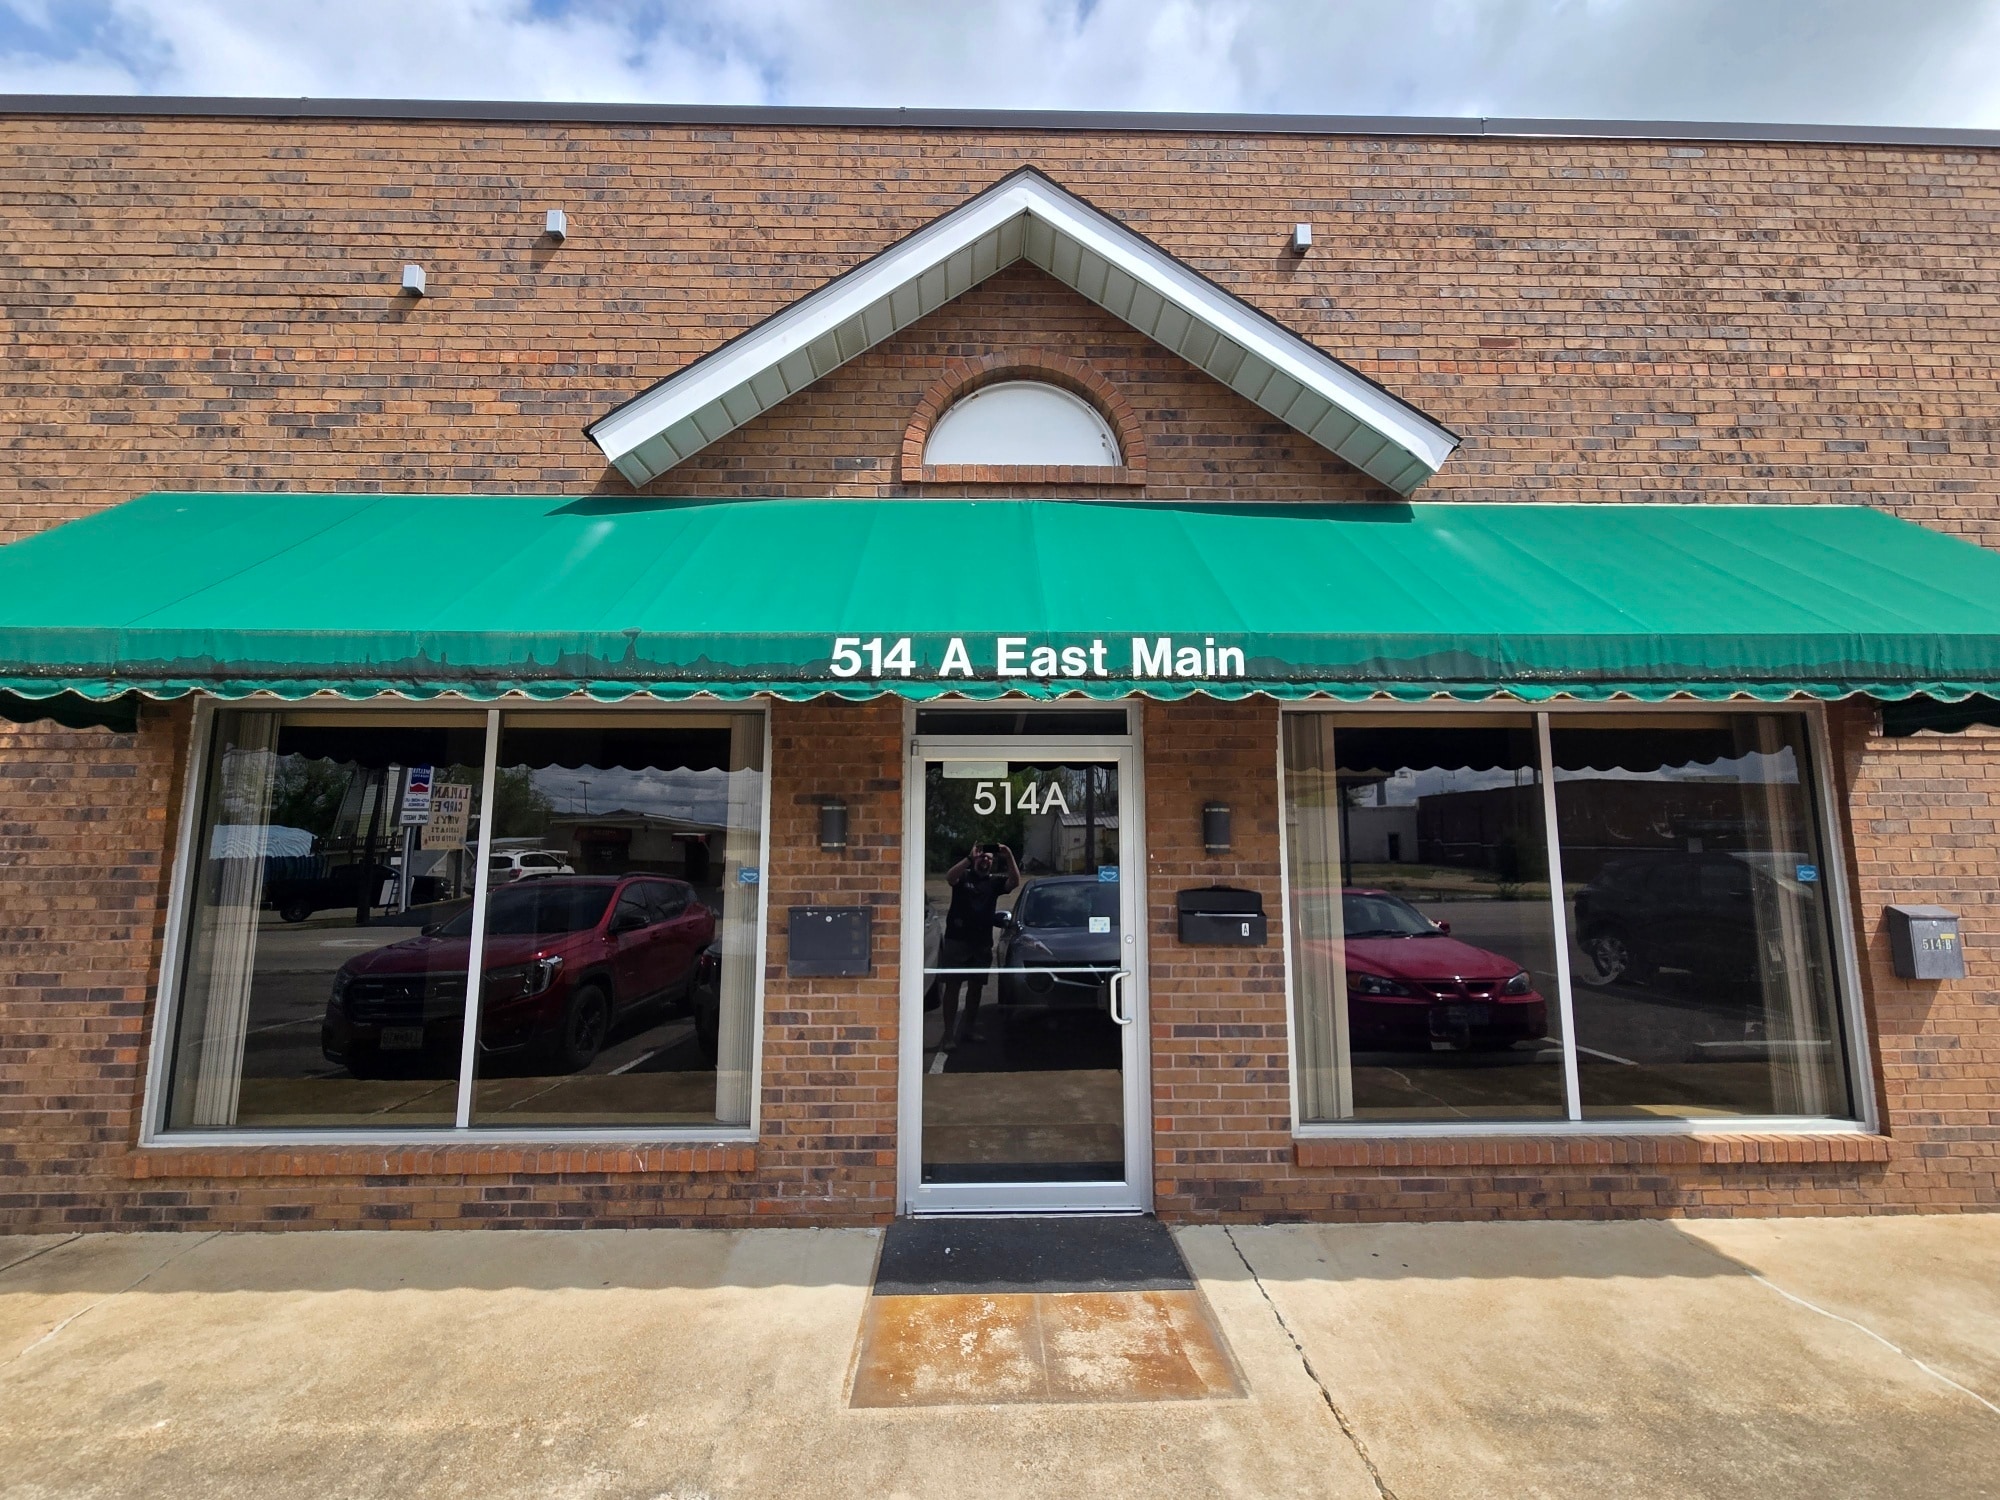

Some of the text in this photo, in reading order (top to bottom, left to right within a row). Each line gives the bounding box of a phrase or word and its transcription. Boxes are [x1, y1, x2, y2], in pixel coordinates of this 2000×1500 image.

[829, 637, 1246, 677] 514 A East Main
[973, 781, 1070, 815] 514A
[1242, 923, 1249, 935] A
